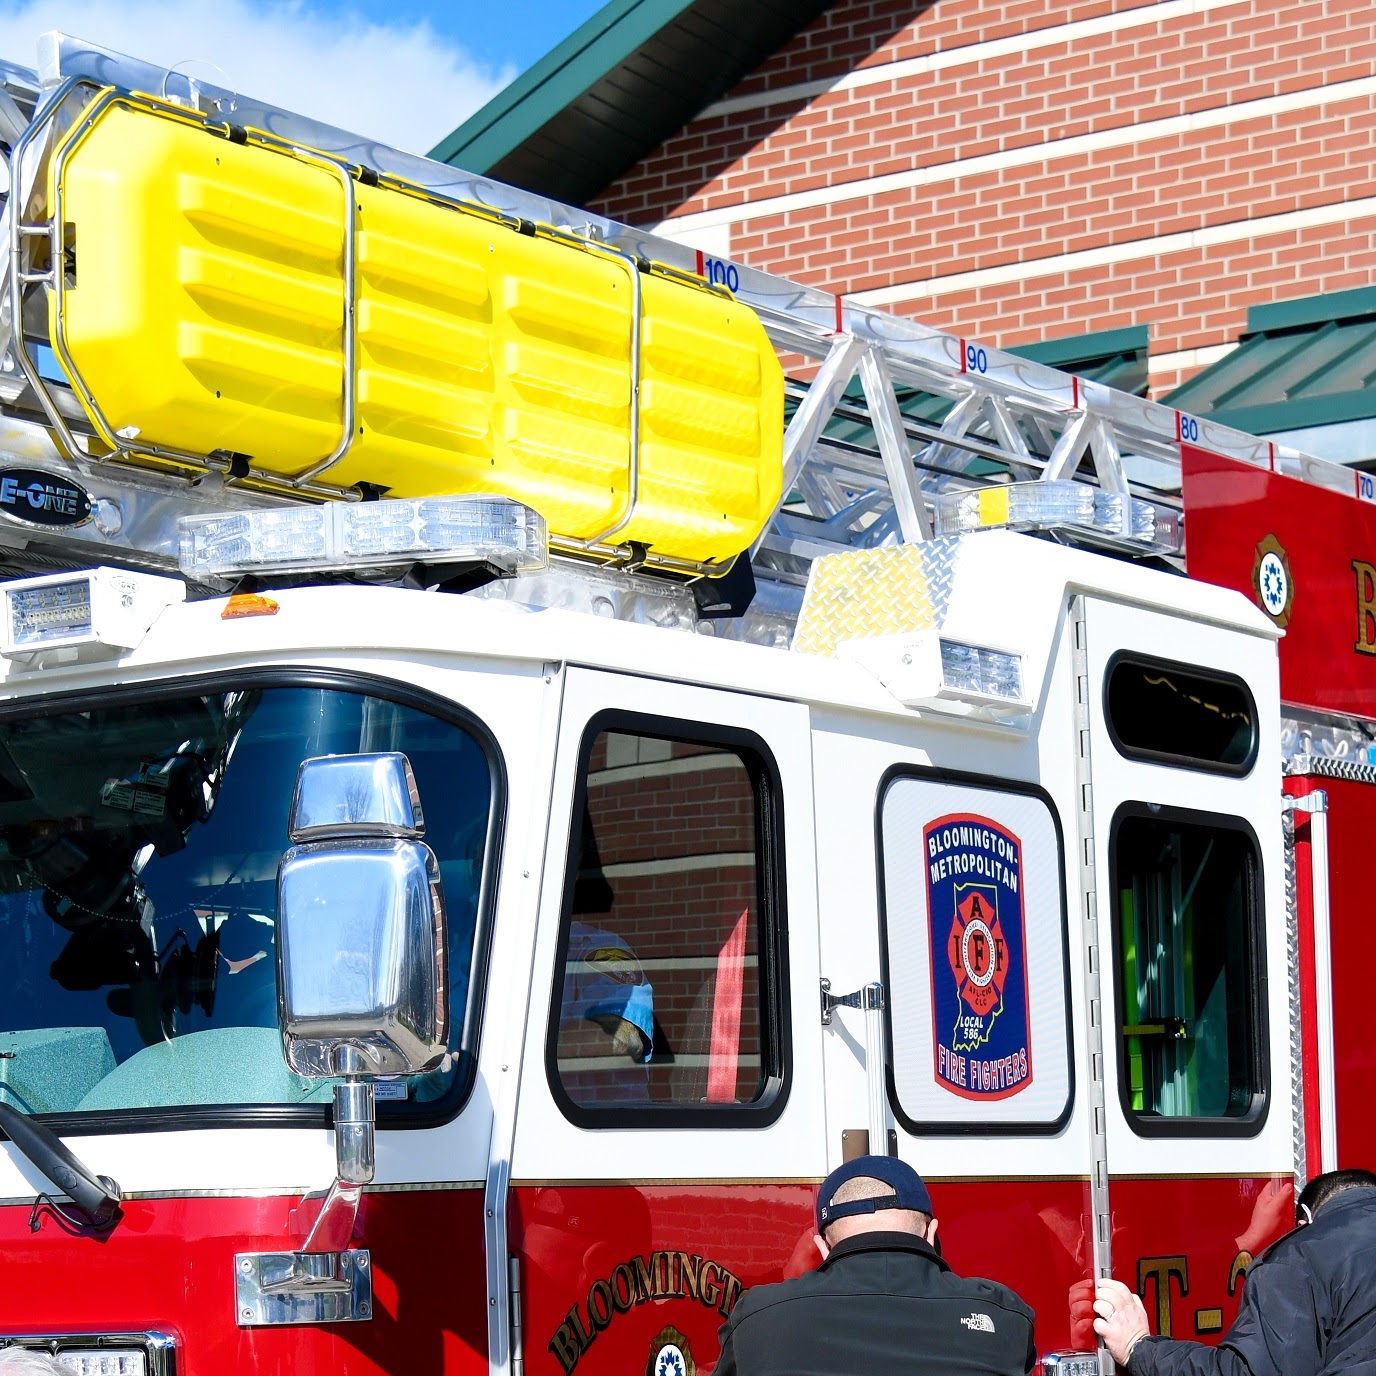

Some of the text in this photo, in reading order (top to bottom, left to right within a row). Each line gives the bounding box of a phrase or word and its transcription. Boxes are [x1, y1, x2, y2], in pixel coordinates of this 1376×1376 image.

[706, 259, 738, 293] 100
[967, 346, 987, 373] 90
[1181, 416, 1198, 442] 80
[0, 478, 79, 515] E-ONE
[1360, 476, 1373, 498] 70
[930, 853, 1017, 893] METROPOLITAN
[970, 896, 984, 918] A
[973, 935, 984, 971] F
[960, 1016, 983, 1028] LOCAL
[964, 1028, 979, 1039] 586
[938, 1044, 1027, 1090] FIRE FIGHTERS
[960, 1317, 984, 1325] NORTH
